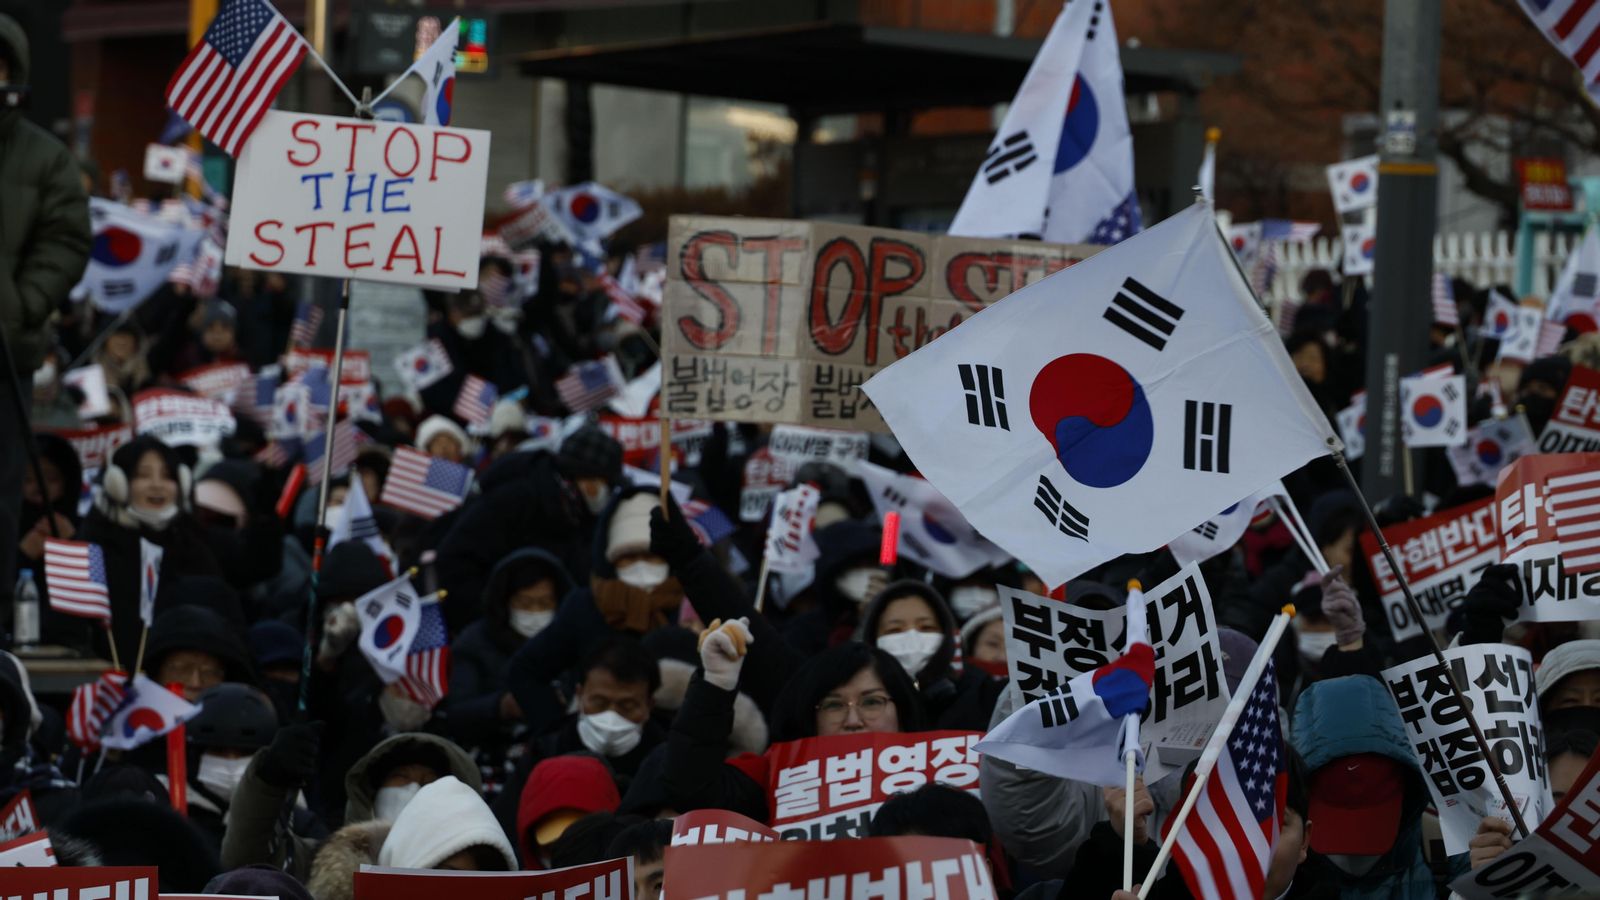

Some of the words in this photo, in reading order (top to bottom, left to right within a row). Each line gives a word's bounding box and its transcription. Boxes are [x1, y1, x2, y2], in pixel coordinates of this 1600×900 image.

[287, 120, 472, 181] STOP
[301, 172, 415, 214] THE
[248, 220, 467, 278] STEAL
[677, 230, 925, 366] STOP
[775, 735, 980, 819] 불법영장
